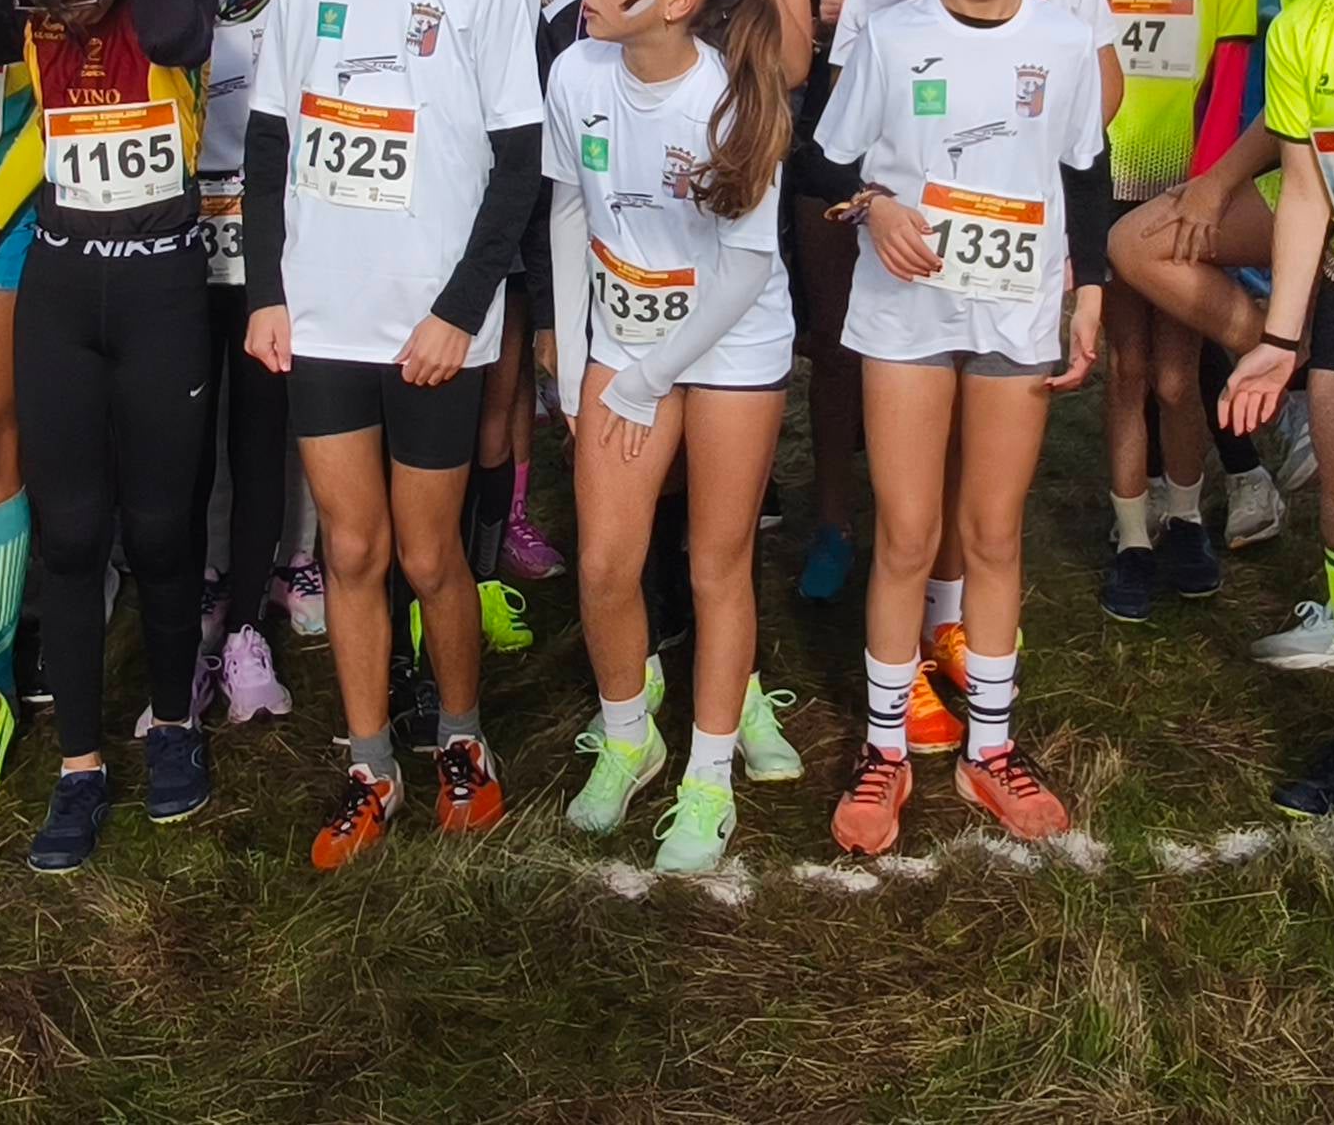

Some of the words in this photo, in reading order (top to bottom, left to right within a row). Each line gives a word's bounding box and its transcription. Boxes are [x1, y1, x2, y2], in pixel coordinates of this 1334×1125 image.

[1121, 20, 1166, 53] 47
[67, 88, 121, 105] VINO
[63, 133, 175, 184] 1165
[306, 127, 408, 181] 1325
[83, 235, 179, 257] NIKE
[932, 219, 1037, 273] 1335
[596, 272, 689, 322] 1338
